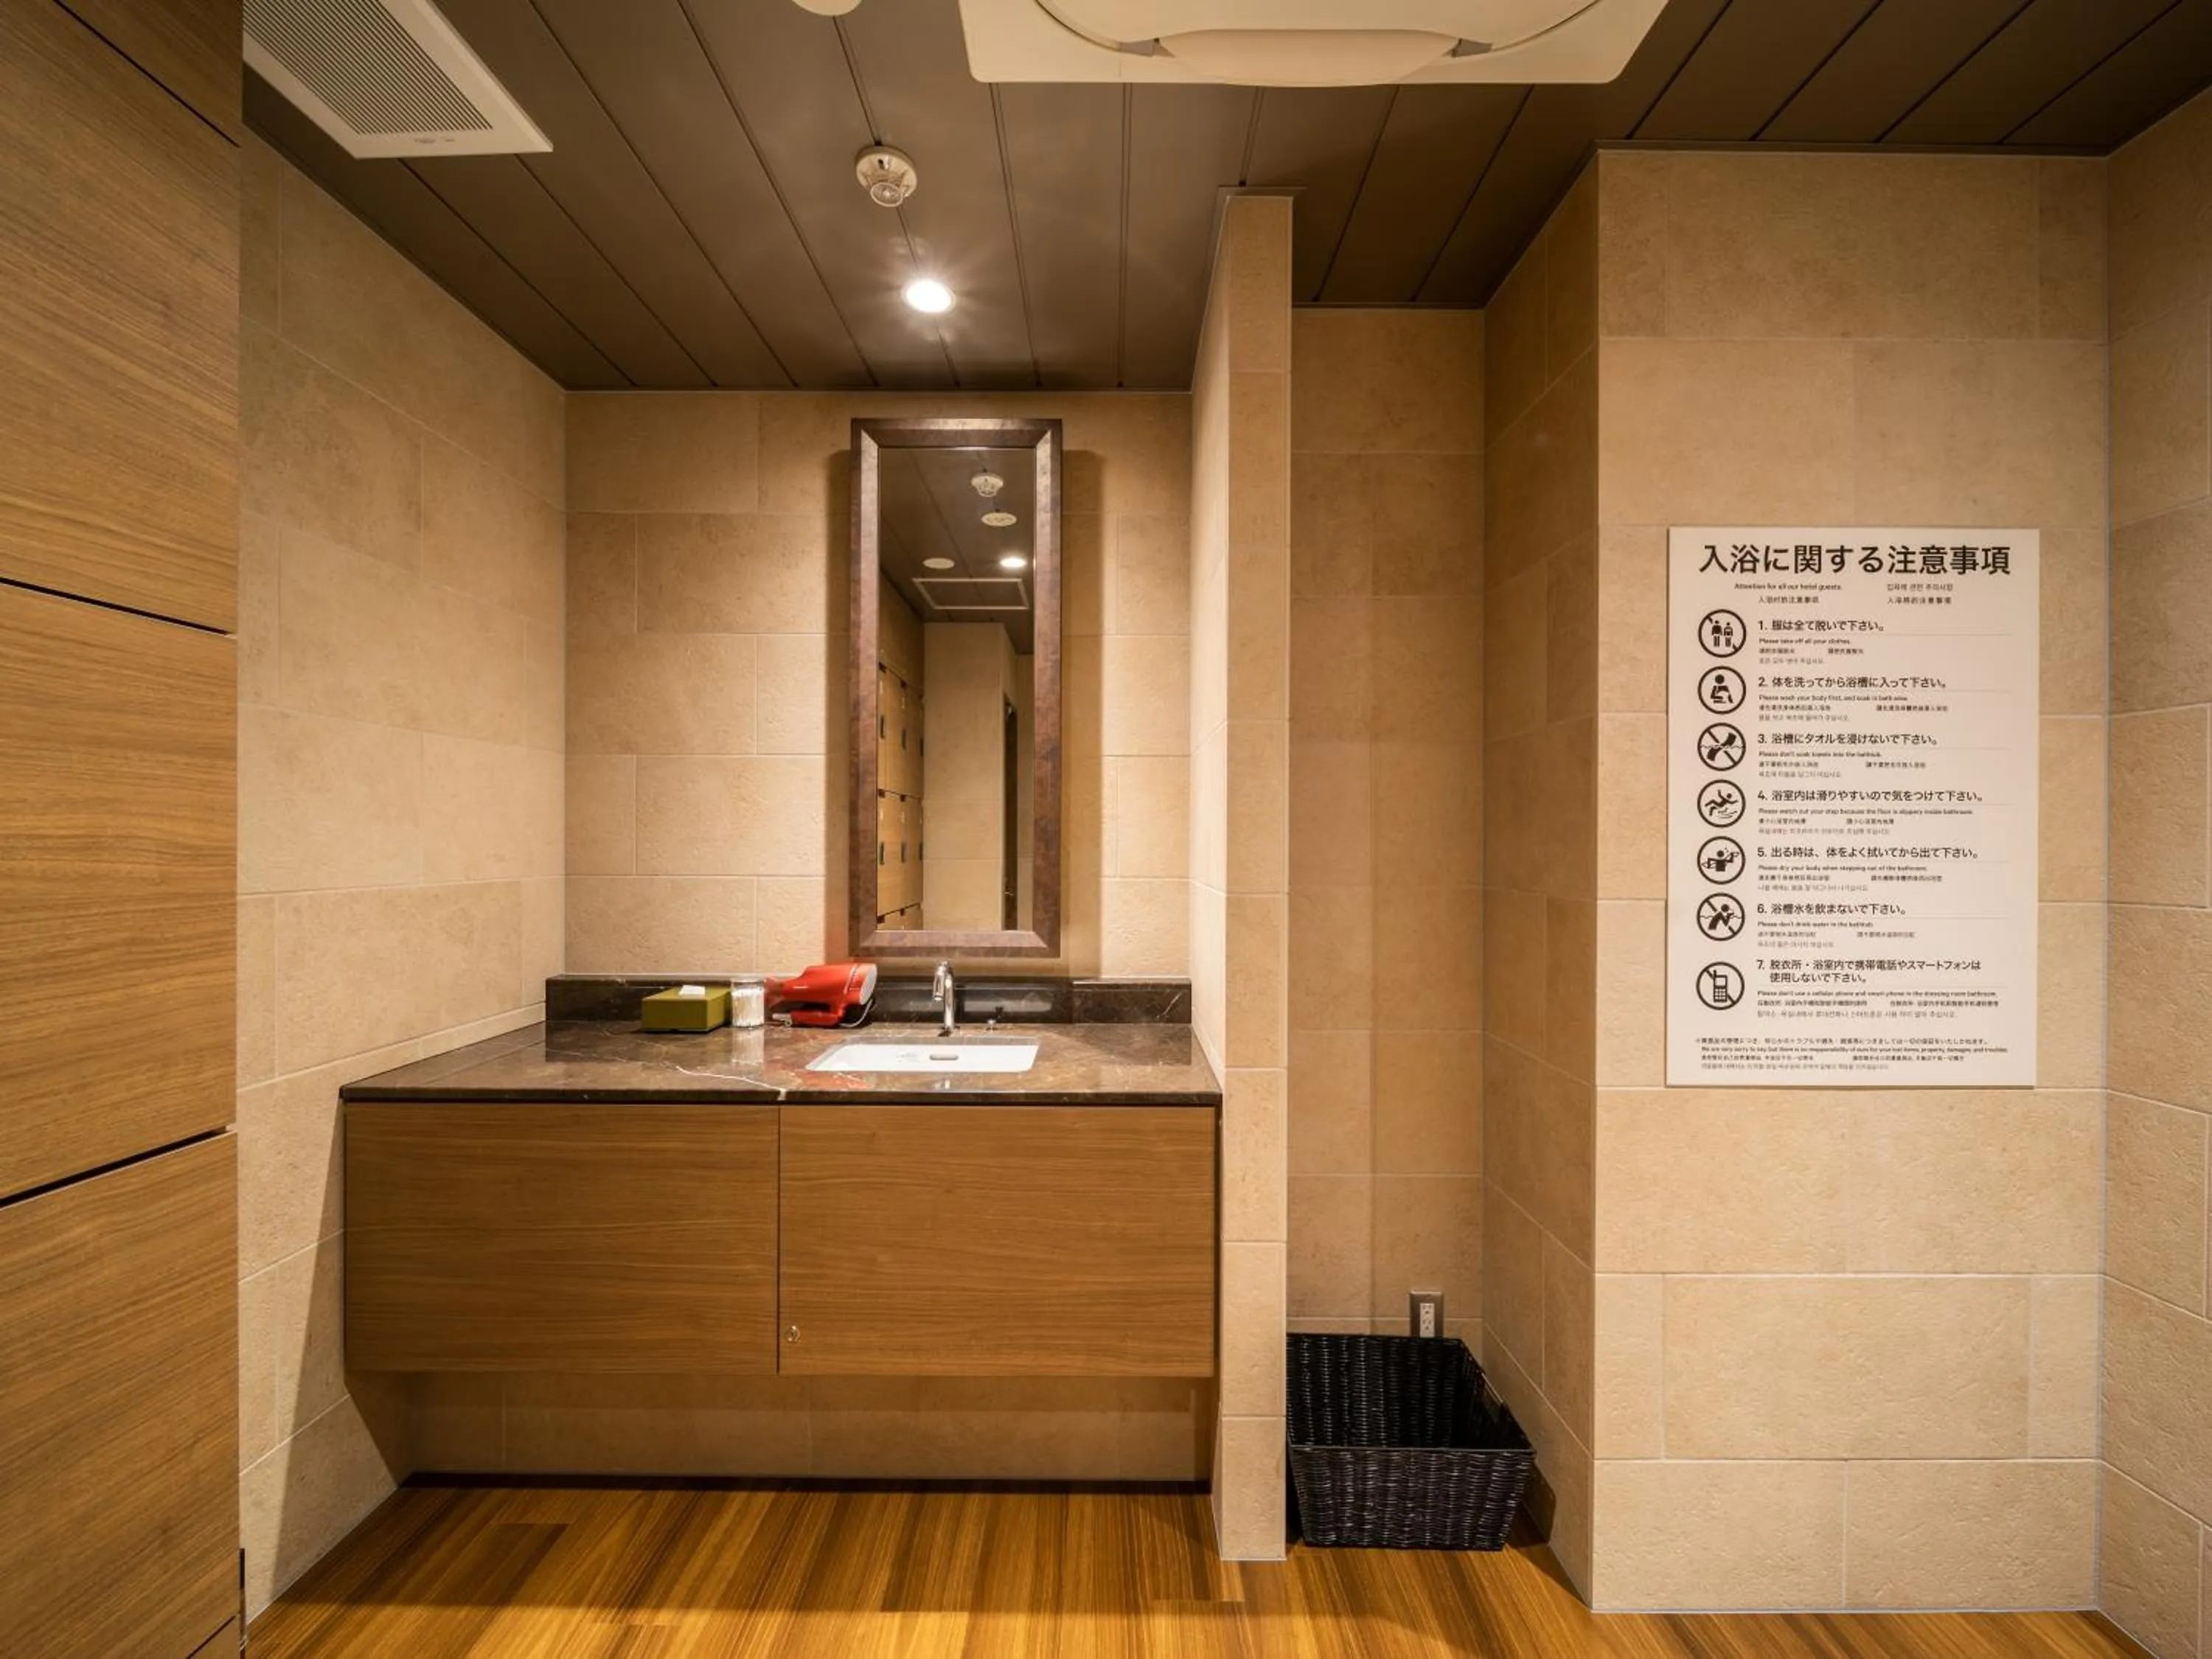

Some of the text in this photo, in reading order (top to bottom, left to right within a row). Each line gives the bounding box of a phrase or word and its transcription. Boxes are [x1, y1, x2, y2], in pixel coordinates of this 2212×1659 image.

[1699, 544, 2011, 575] 入浴に関する注意事項
[1758, 619, 1885, 632] 1. 服は全て脱いで下さい。
[1758, 676, 1946, 689] 2. 体を洗ってから浴槽に入って下さい。
[1757, 733, 1938, 745] 3. 浴槽にタオルを浸けないで下さい。
[1757, 790, 1983, 802] 4. 浴室内は滑りやすいので気をつけて下さい。
[1757, 846, 1767, 858] 5.
[1757, 903, 1907, 915] 6. 浴槽水を飲まないで下さい。
[1756, 959, 1981, 970] 7. 脱衣所・浴室内で携帯電話やスマートフォンは
[1769, 973, 1867, 984] 使用しないで下さい。
